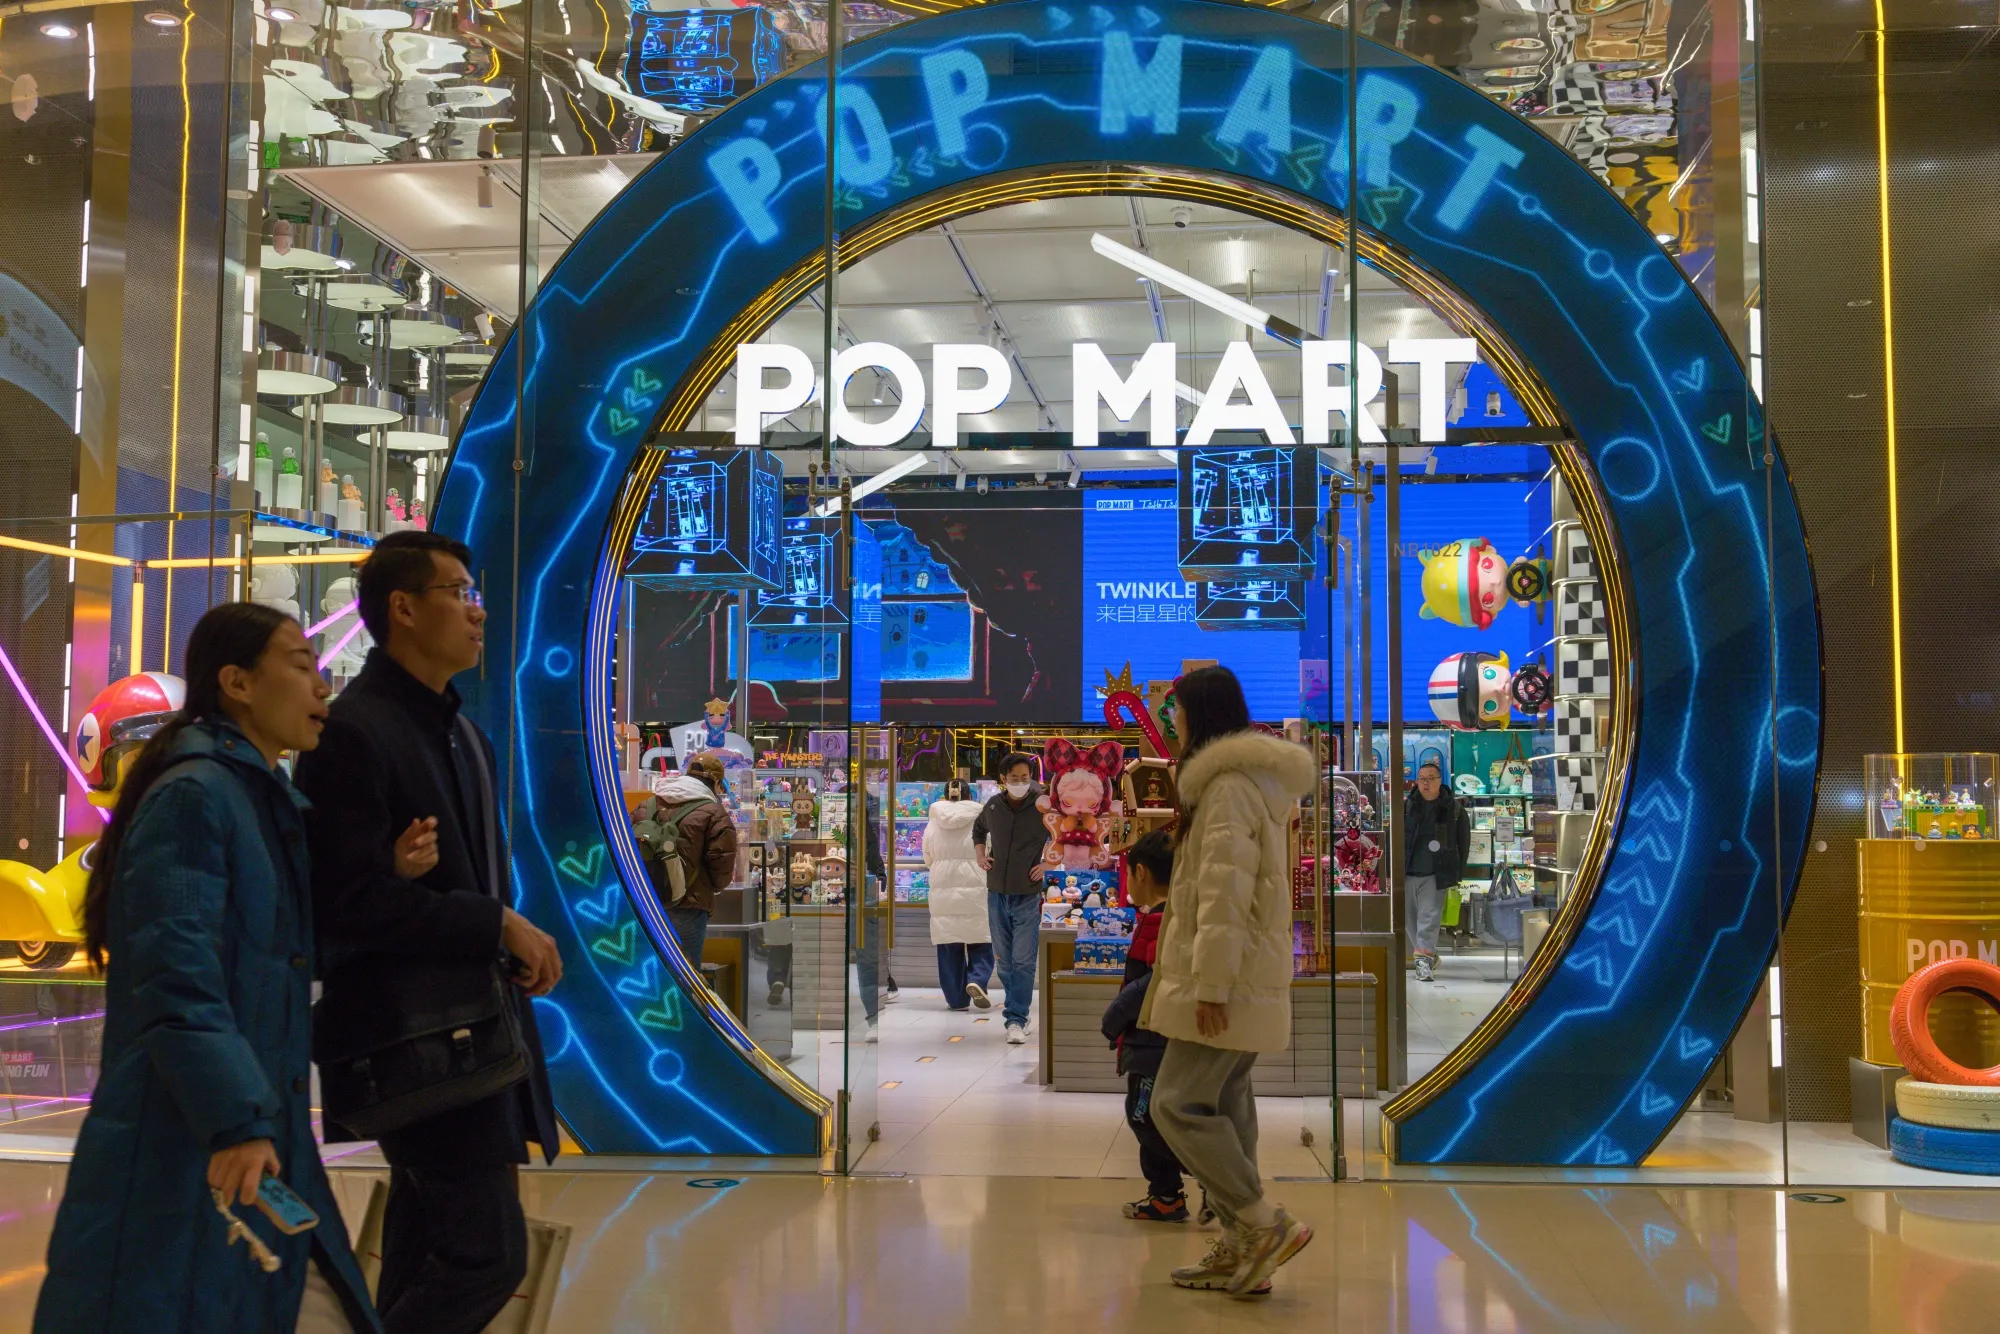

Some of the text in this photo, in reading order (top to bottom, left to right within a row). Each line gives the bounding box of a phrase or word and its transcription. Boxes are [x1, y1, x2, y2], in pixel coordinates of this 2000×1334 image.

[706, 31, 1526, 244] POP MART
[735, 338, 1477, 447] POP MART
[1393, 542, 1462, 558] NB1022
[1096, 581, 1197, 599] TWINKLE
[1096, 603, 1196, 623] 来自星星的
[1906, 938, 1969, 974] POP
[23, 1063, 50, 1078] FUN
